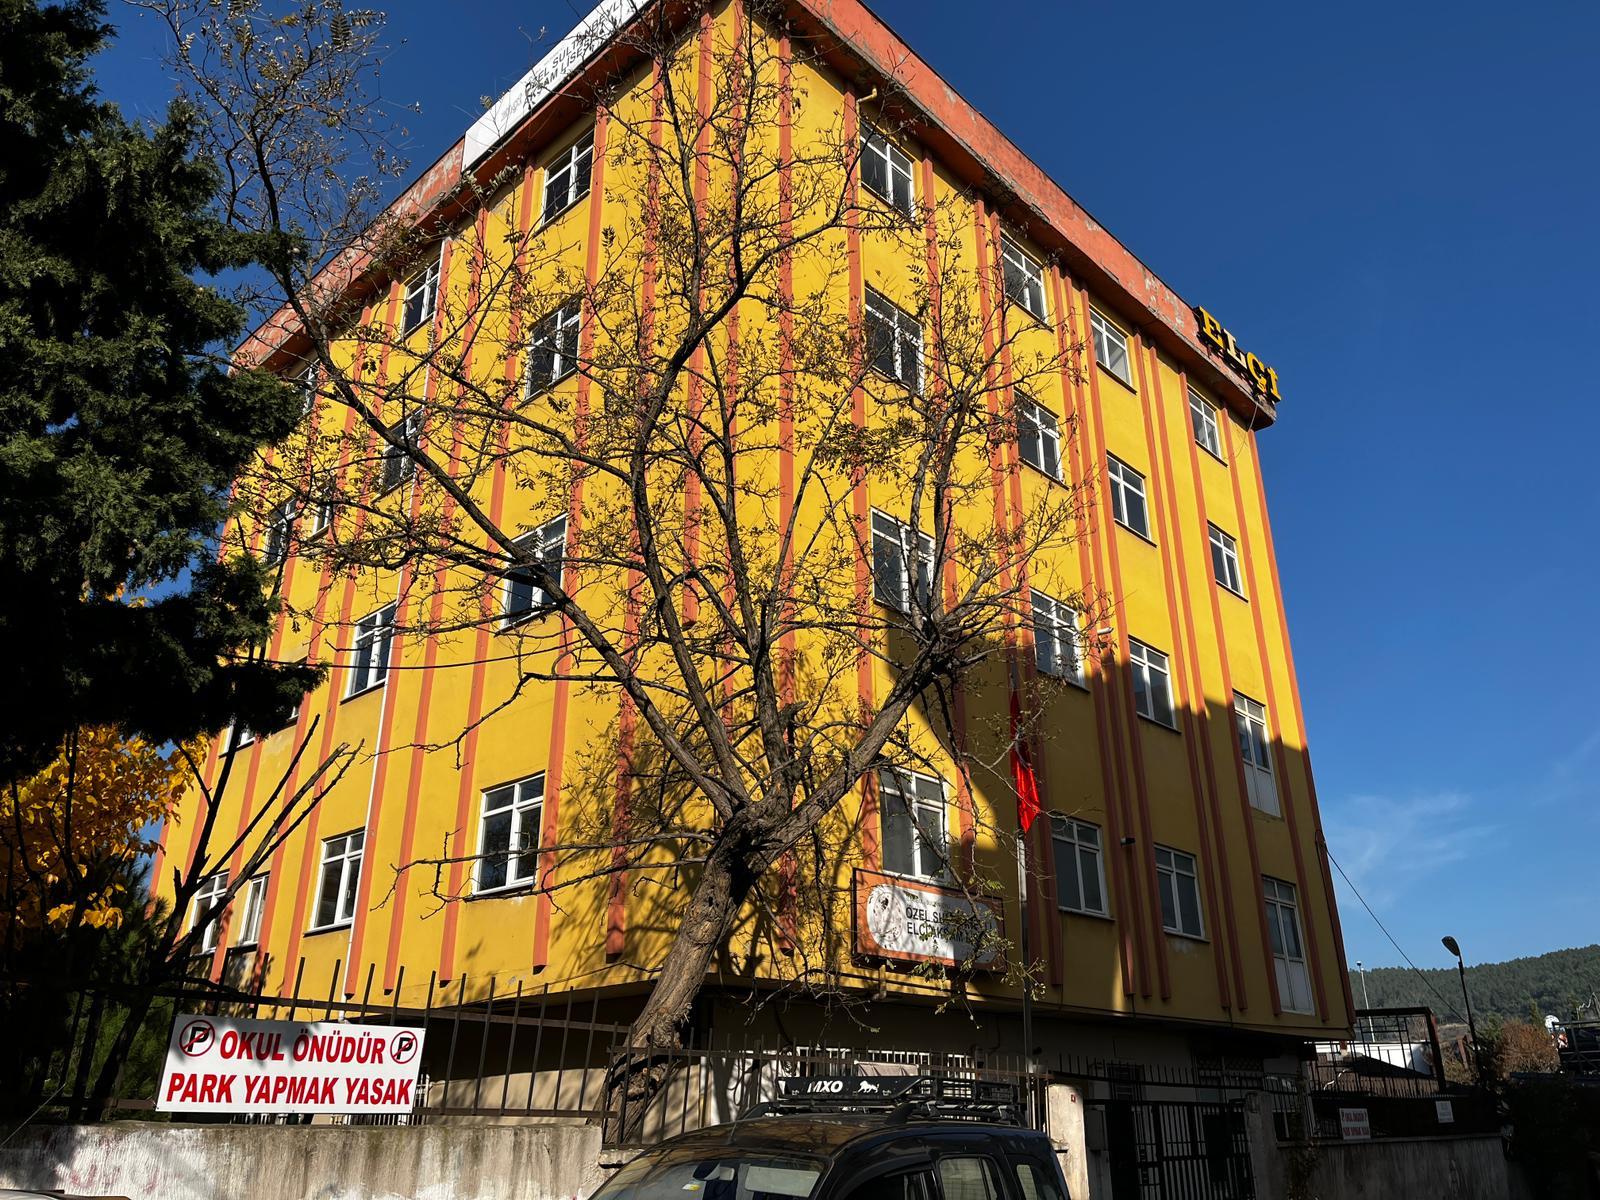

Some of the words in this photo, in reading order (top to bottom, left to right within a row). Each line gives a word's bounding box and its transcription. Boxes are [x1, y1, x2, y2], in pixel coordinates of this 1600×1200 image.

[220, 1030, 285, 1061] OKUL
[293, 1028, 386, 1064] ÖNÜDÜR
[166, 1072, 237, 1103] PARK
[244, 1074, 338, 1105] YAPMAK
[345, 1077, 413, 1105] YASAK
